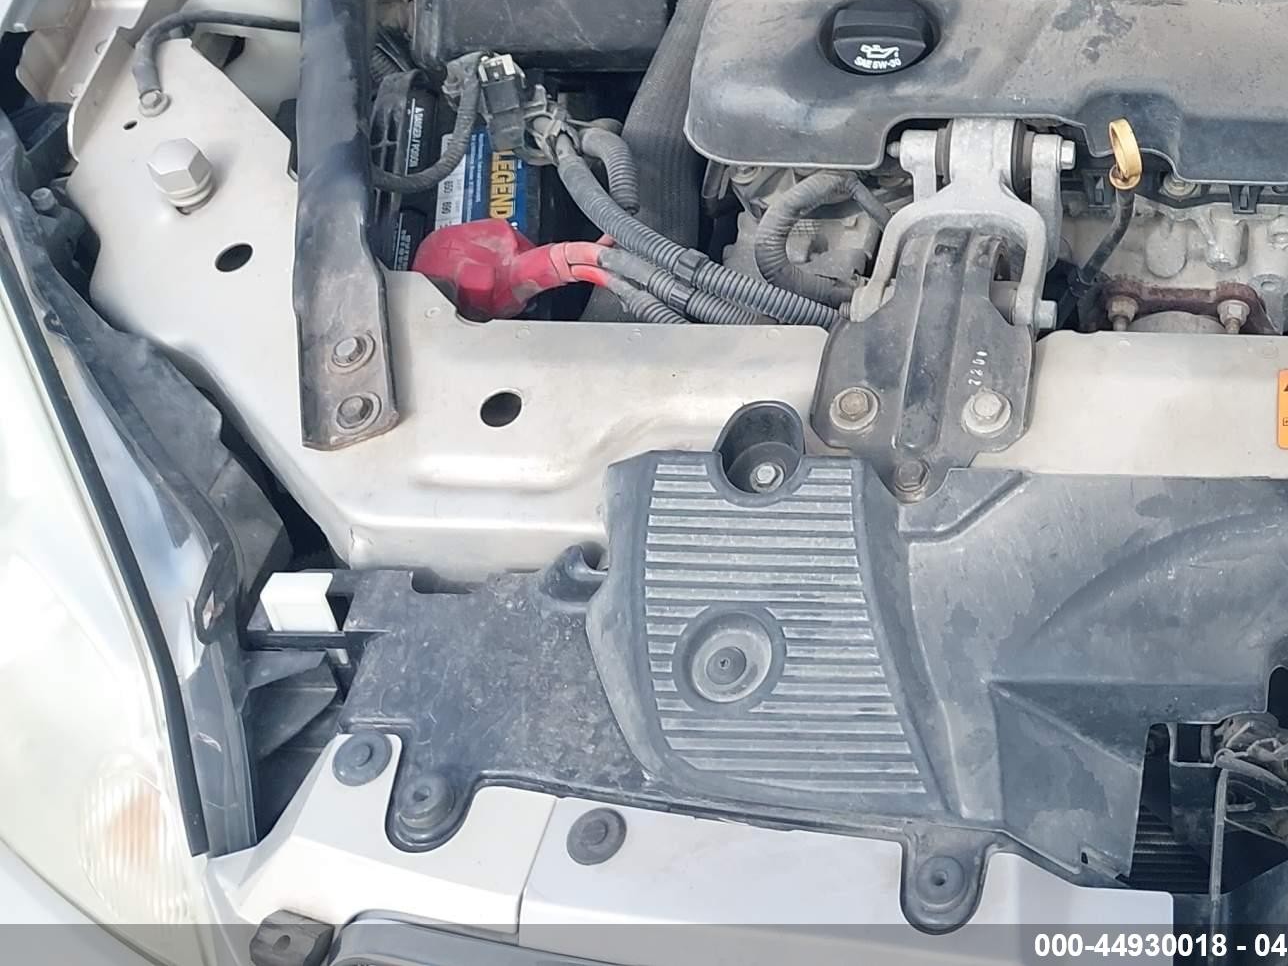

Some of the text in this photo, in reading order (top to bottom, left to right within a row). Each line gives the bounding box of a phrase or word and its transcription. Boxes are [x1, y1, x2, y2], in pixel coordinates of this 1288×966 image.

[854, 56, 902, 70] SAE 5W-30
[490, 150, 516, 220] LEGEND
